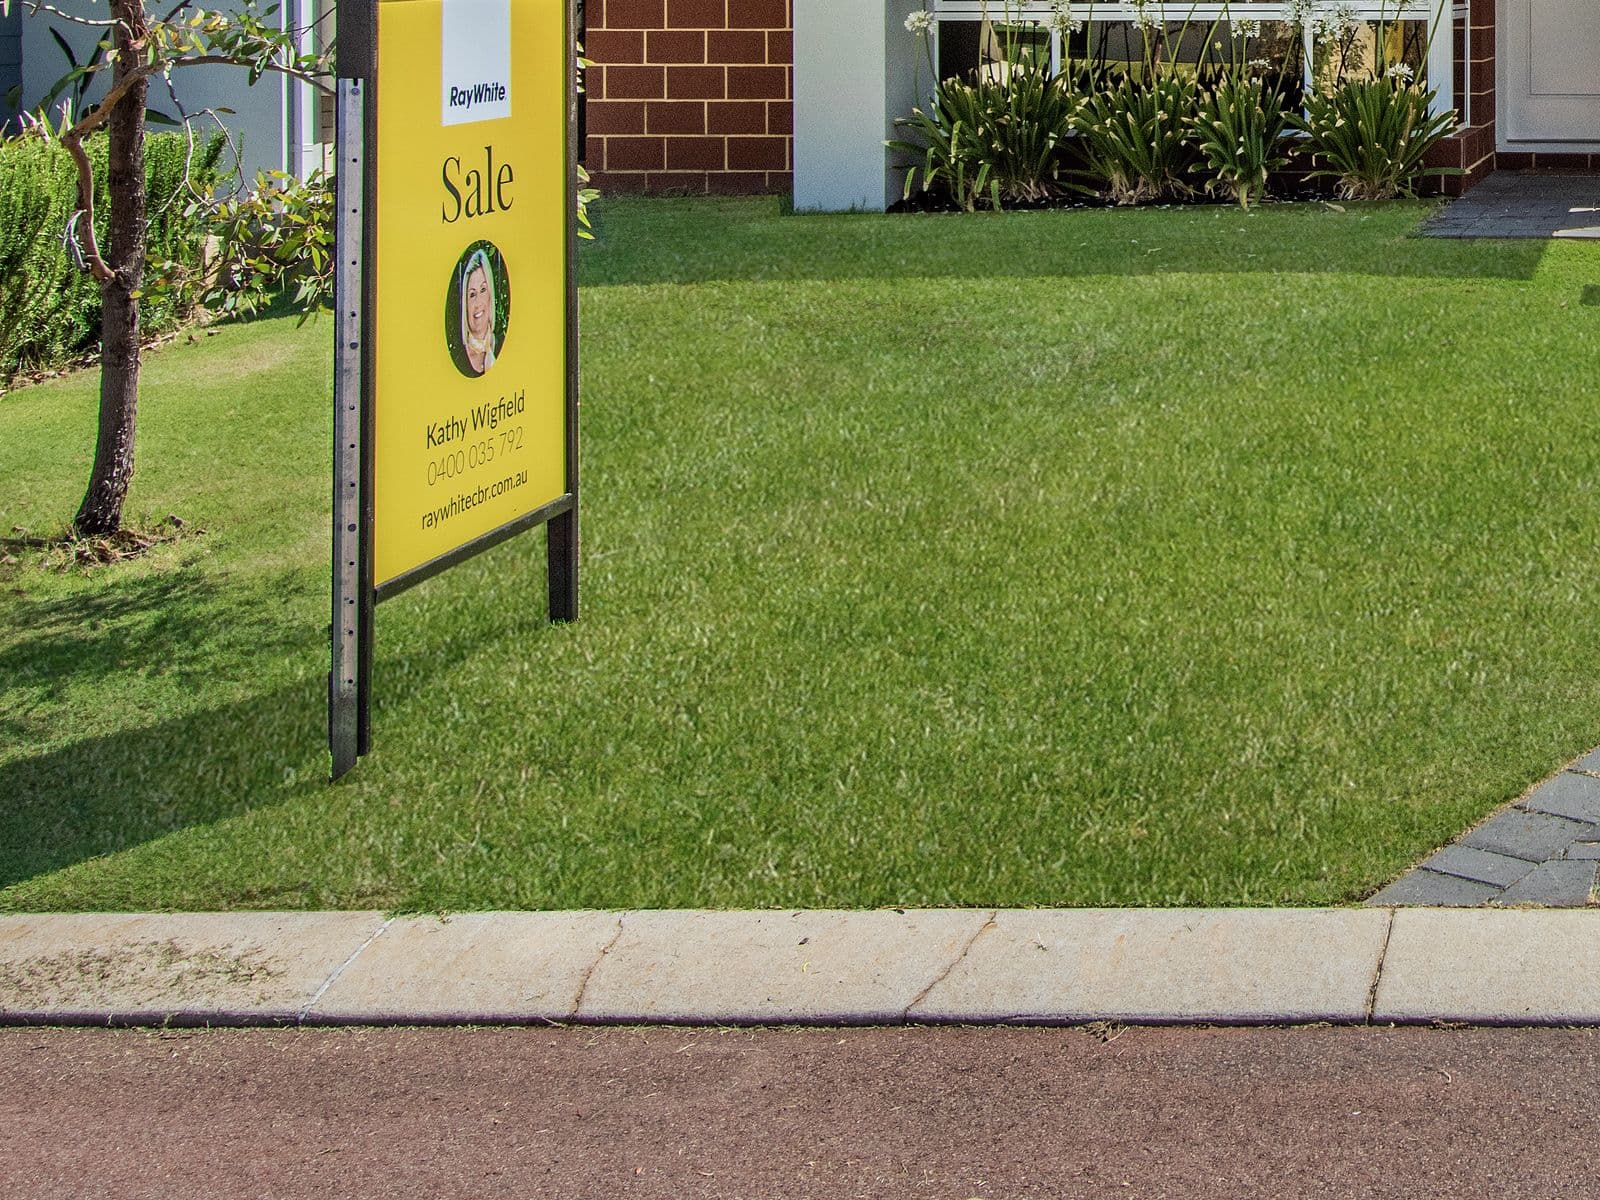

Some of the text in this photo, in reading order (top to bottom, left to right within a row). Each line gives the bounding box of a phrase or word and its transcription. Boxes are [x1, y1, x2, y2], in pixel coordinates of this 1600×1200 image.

[442, 145, 514, 224] Sale
[426, 389, 525, 450] Kathy Wigfield
[427, 426, 523, 486] 0400 035 792
[421, 469, 528, 530] raywhitecbr.com.au
